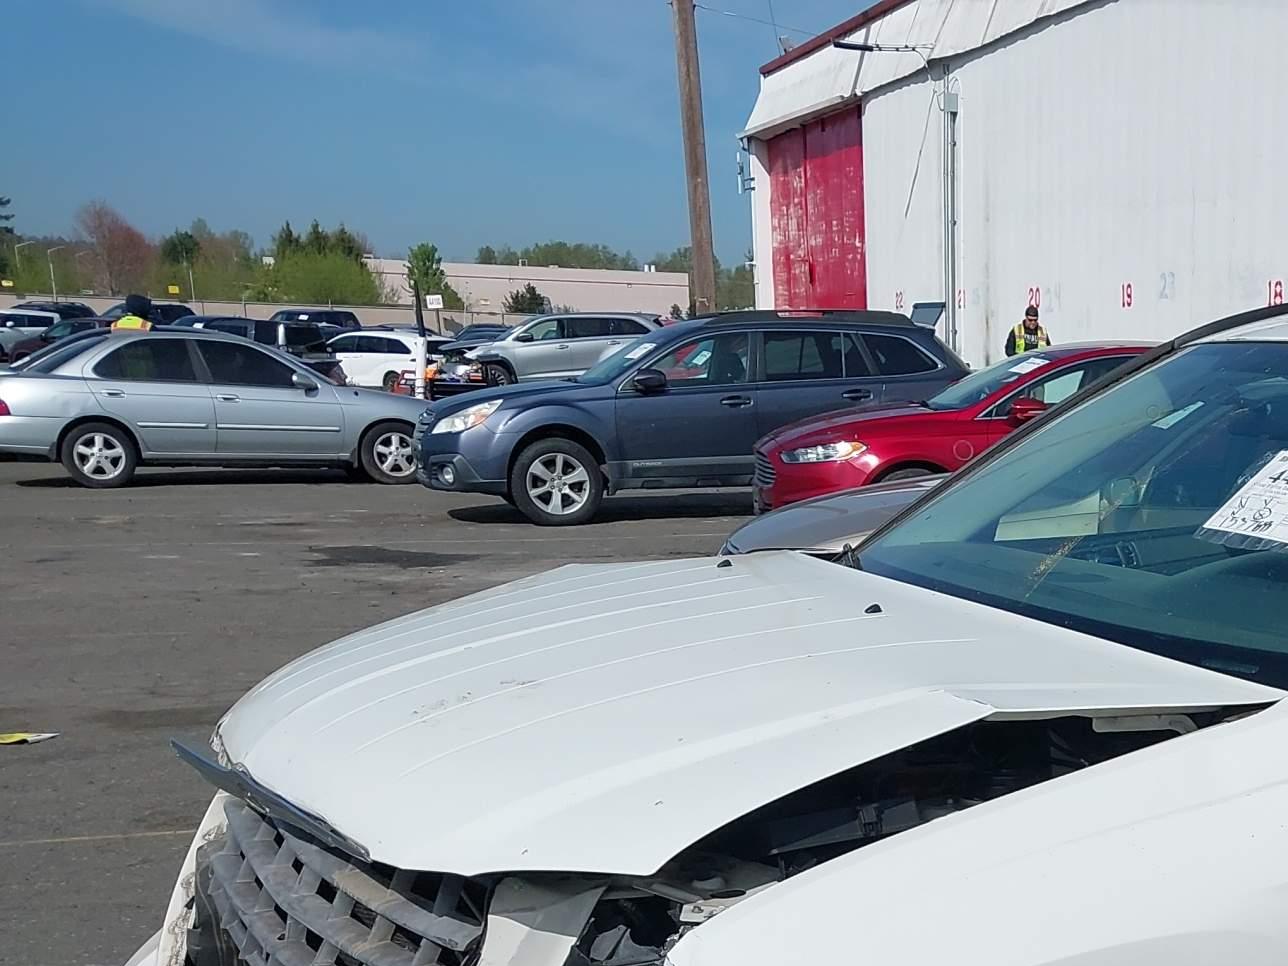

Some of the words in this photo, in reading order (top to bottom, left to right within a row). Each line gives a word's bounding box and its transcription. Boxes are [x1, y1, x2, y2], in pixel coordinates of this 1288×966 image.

[957, 289, 966, 309] 21
[1028, 286, 1041, 309] 20
[1121, 283, 1133, 308] 19
[1267, 280, 1284, 307] 18
